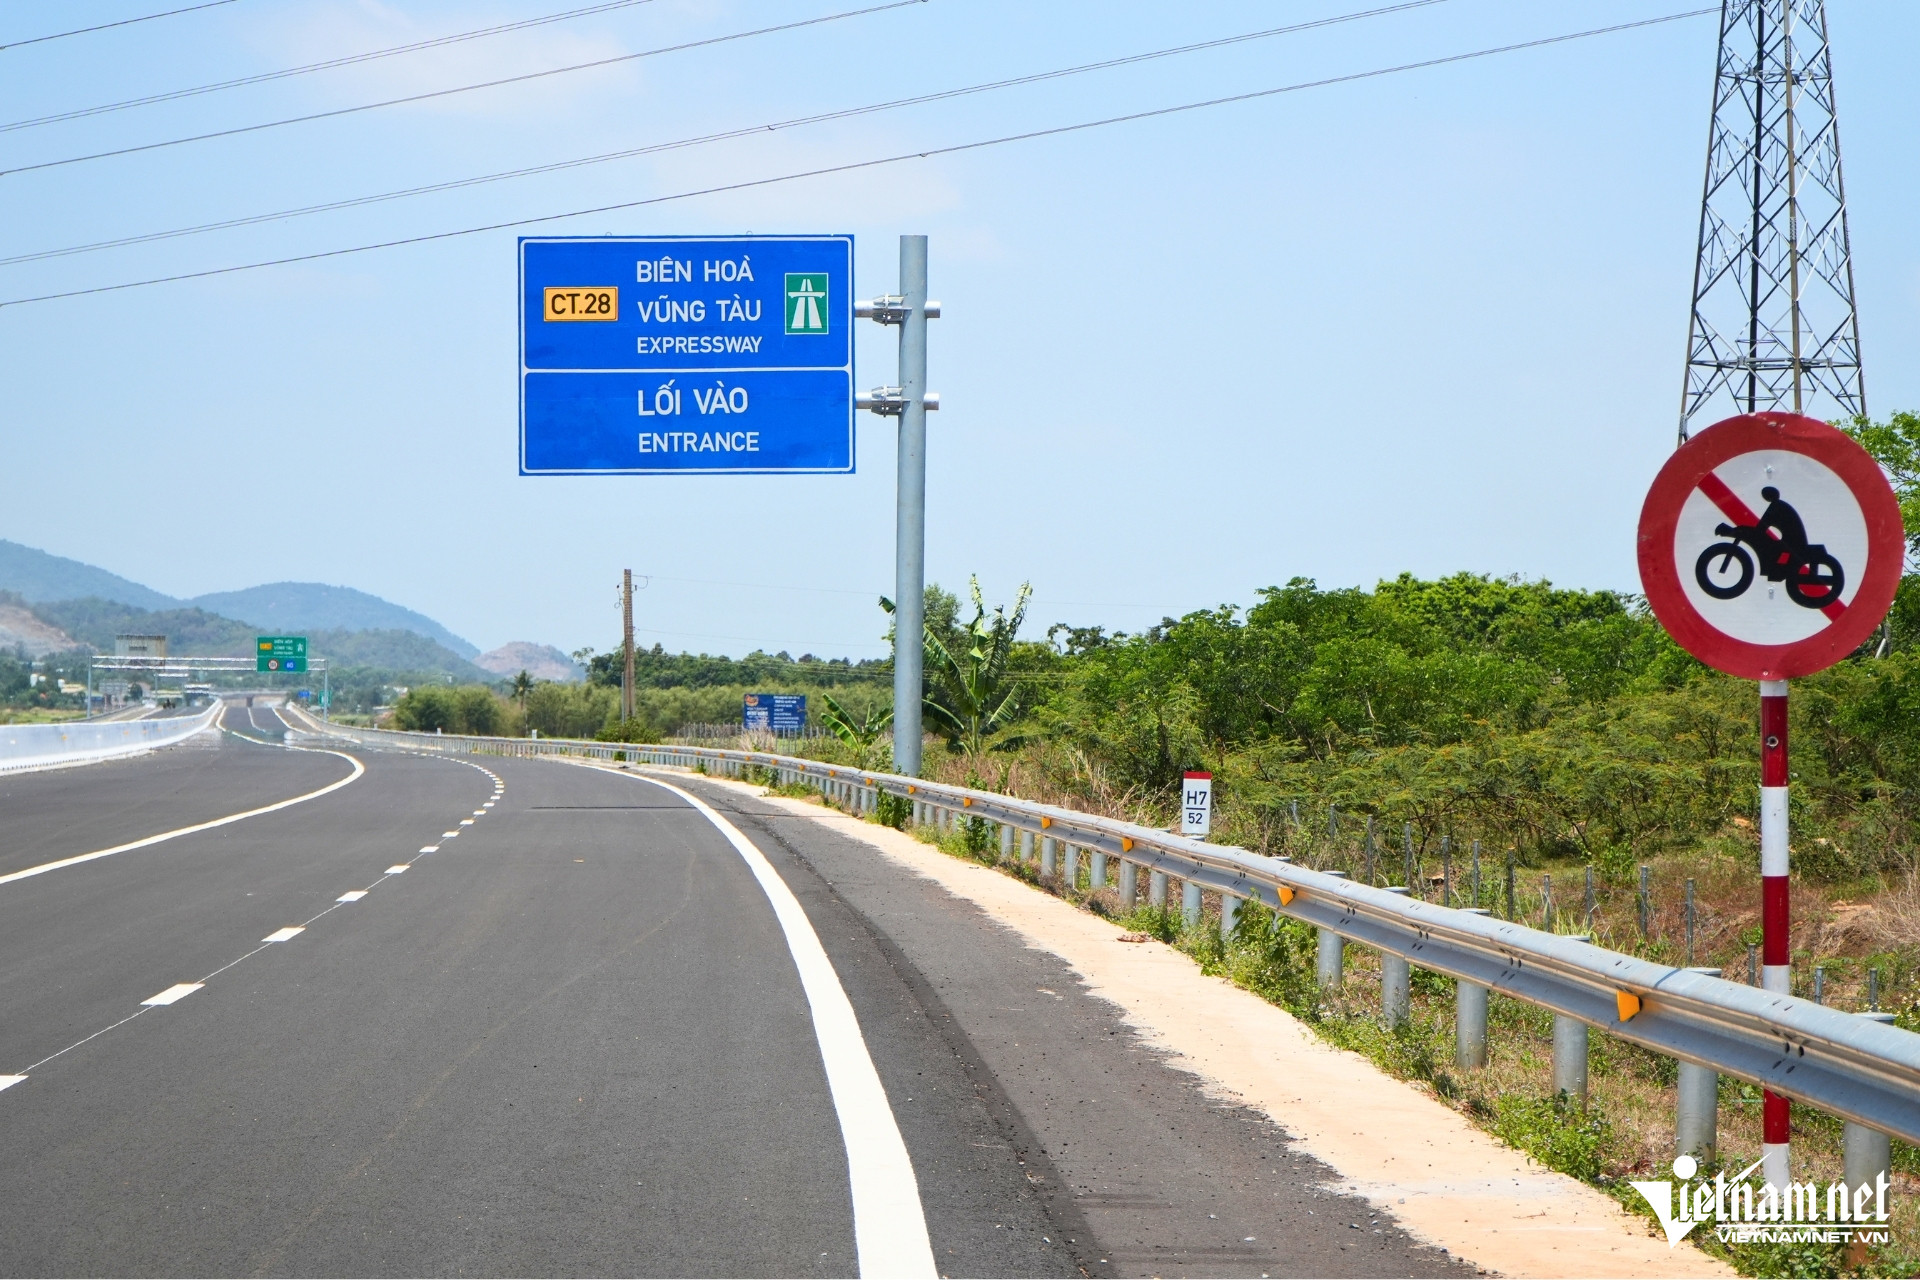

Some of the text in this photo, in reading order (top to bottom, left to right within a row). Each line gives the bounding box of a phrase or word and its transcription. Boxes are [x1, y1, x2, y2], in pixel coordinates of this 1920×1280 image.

[636, 255, 754, 283] BIÊN HOÀ
[551, 293, 611, 314] CT.28
[637, 293, 761, 323] VŨNG TÀU
[637, 336, 763, 354] EXPRESSWAY
[637, 379, 749, 416] LỐI VÀO
[638, 432, 760, 453] ENTRANCE
[1187, 790, 1207, 805] H7
[1188, 812, 1203, 824] 52
